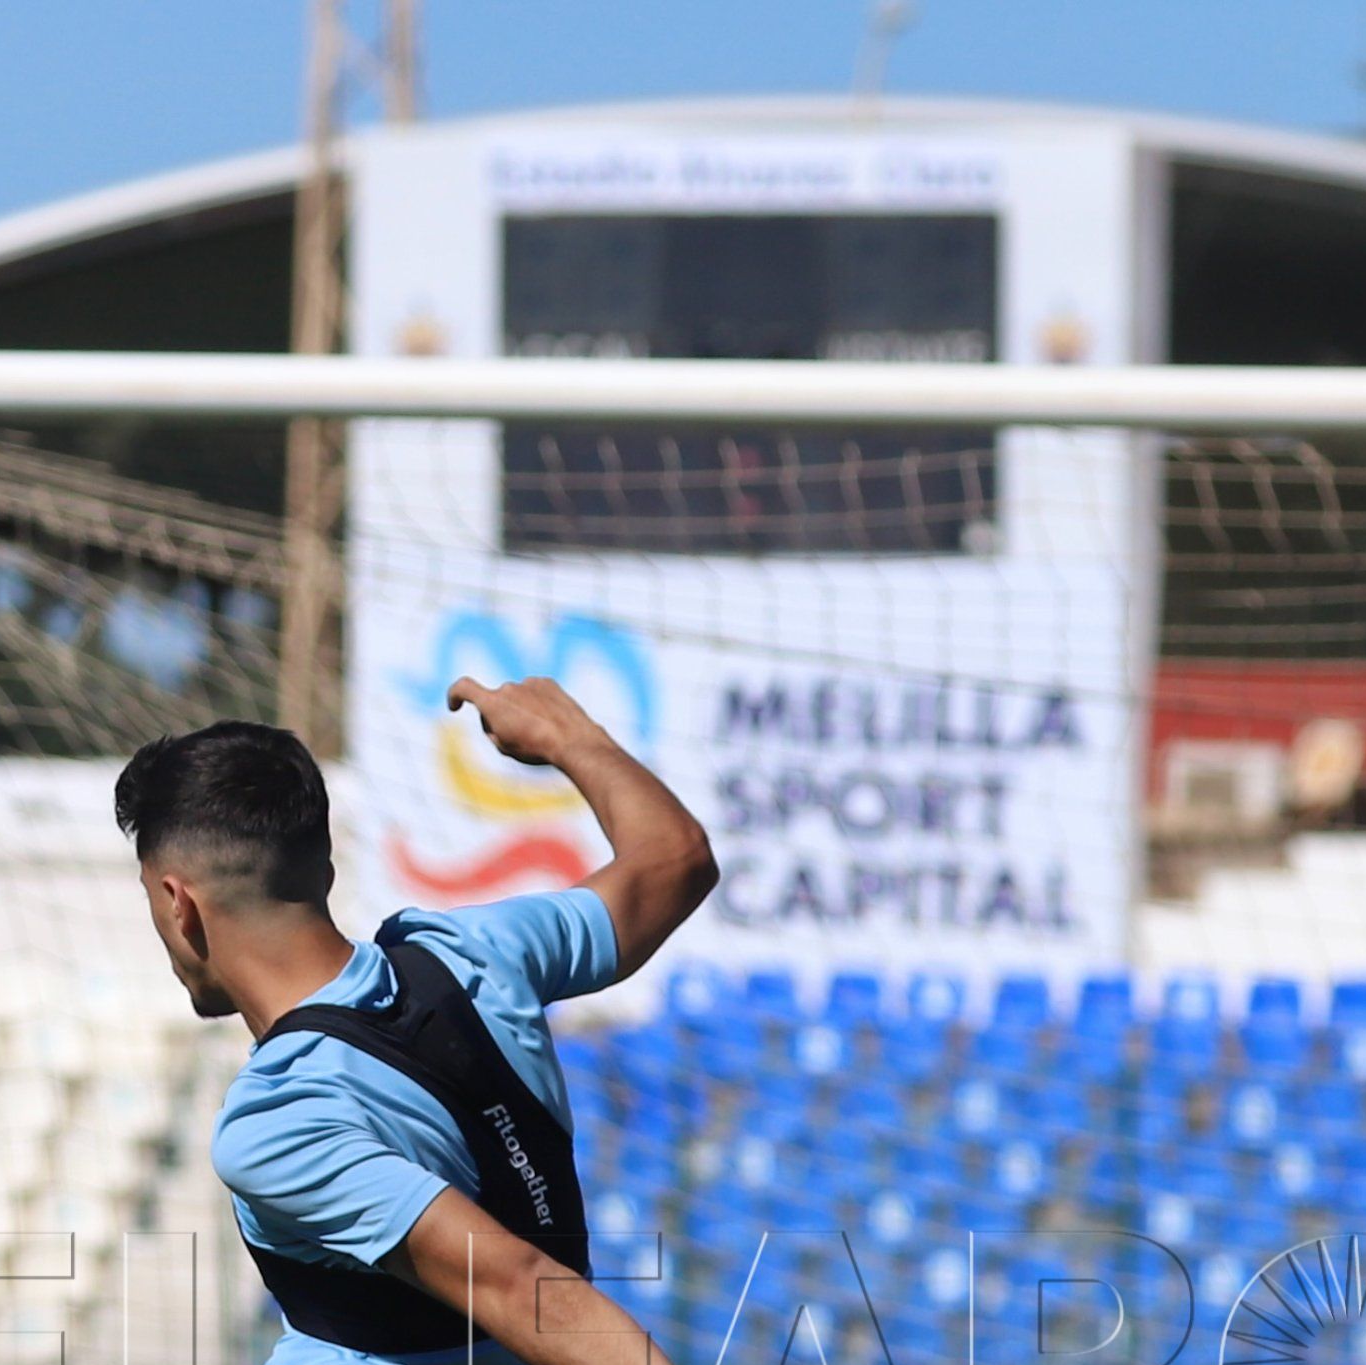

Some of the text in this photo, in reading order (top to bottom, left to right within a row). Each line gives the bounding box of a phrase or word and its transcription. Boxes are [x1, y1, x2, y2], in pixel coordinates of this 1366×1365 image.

[716, 675, 1085, 747] MELILLA
[715, 769, 1010, 838] SPORT
[713, 860, 1079, 930] CAPITAL
[483, 1103, 554, 1227] Fitogether
